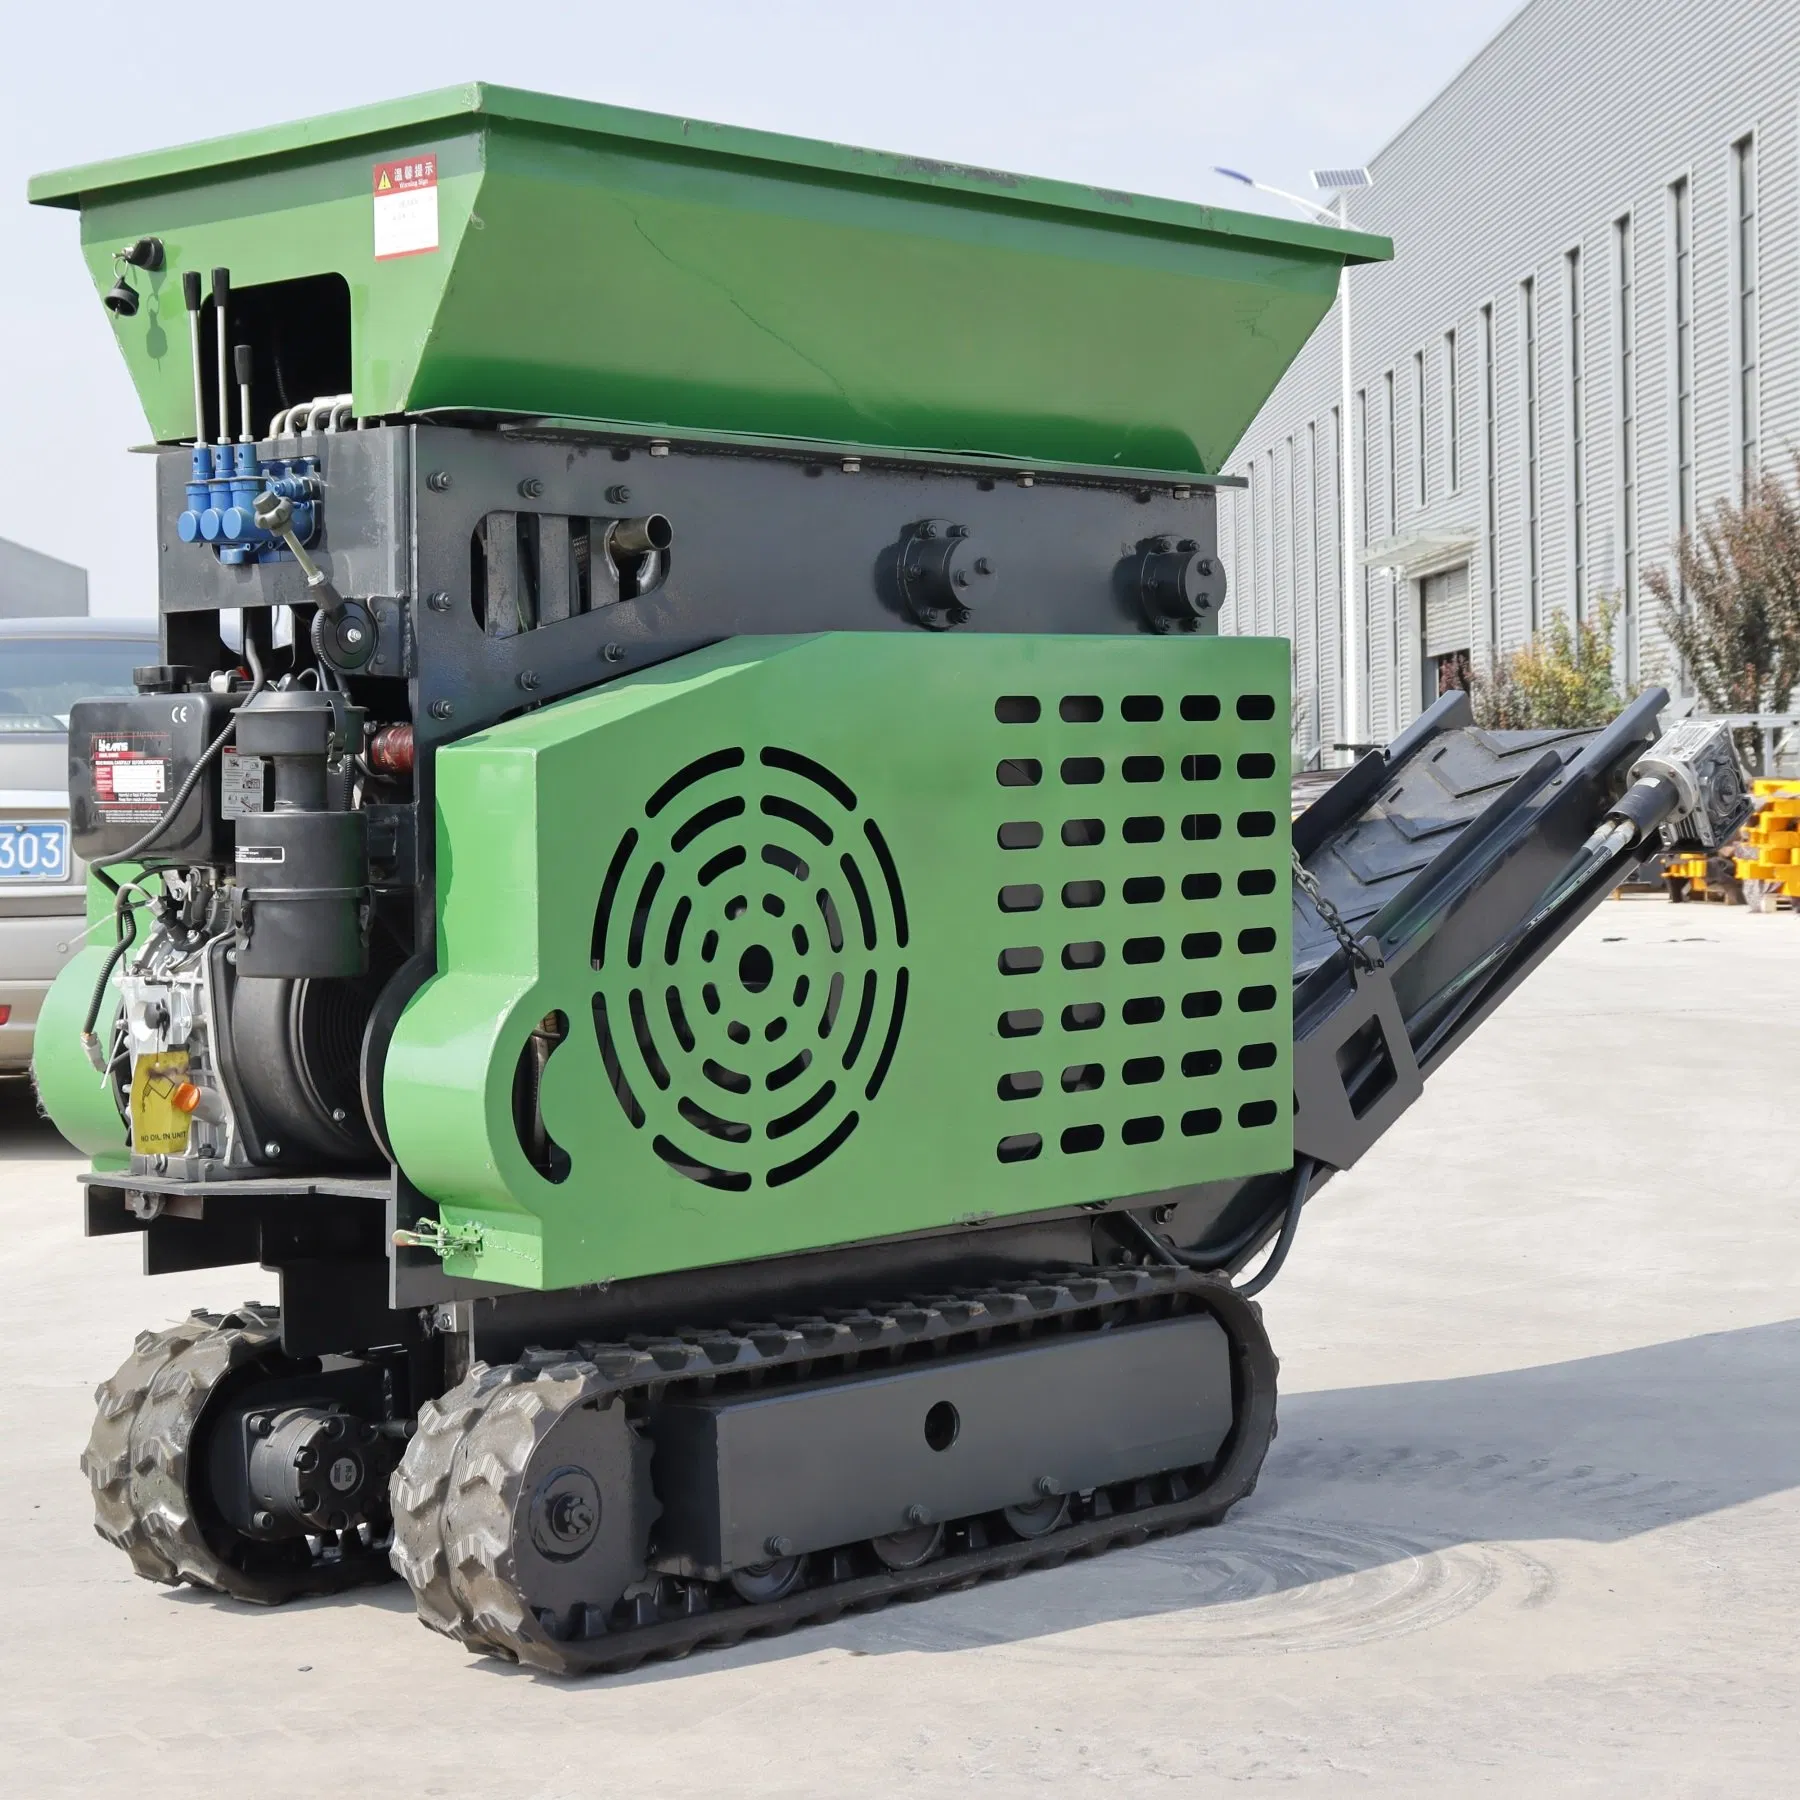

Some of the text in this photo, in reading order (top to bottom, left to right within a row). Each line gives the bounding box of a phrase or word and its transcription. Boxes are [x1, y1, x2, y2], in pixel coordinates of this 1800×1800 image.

[171, 706, 187, 723] CE
[0, 832, 60, 869] 303
[171, 1131, 187, 1139] UNIT
